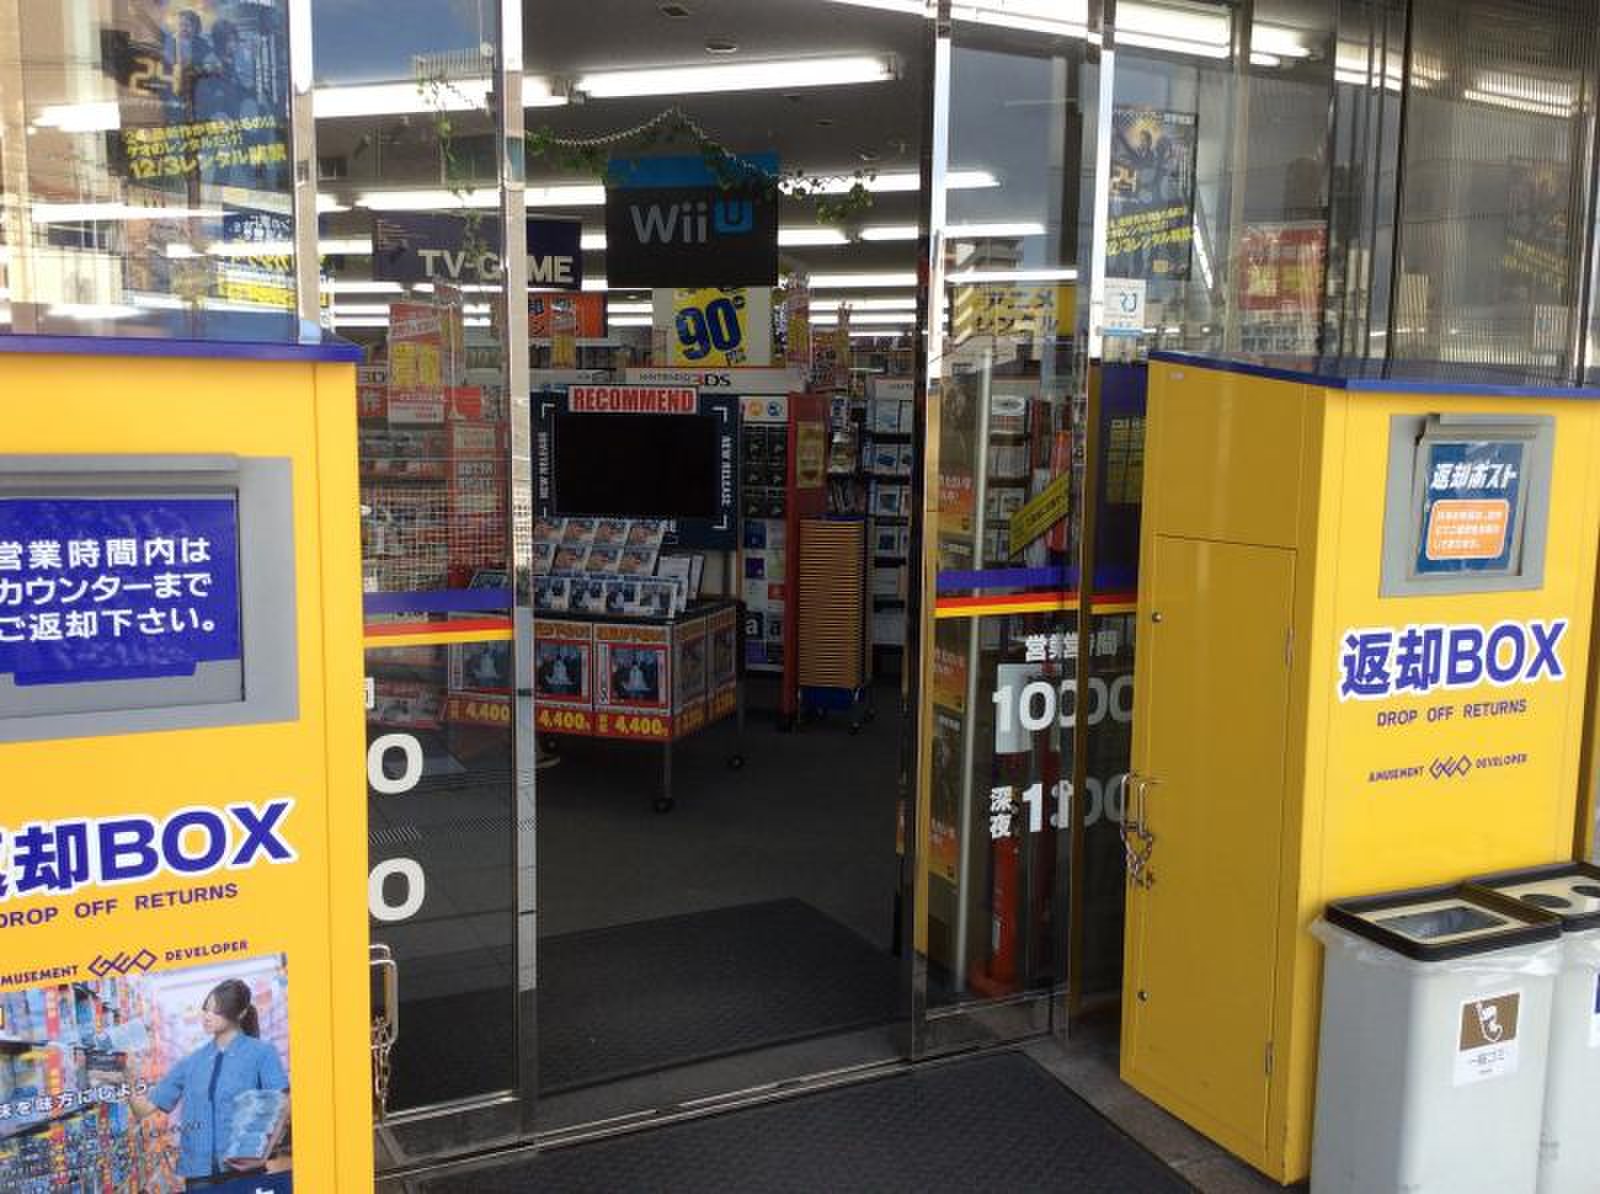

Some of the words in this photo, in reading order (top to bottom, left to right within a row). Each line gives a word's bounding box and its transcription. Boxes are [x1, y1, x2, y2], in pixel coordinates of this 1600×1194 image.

[630, 202, 707, 244] Wii
[417, 249, 573, 283] TV-GME
[692, 371, 732, 386] 3DS
[574, 387, 695, 411] RECOMMEND
[0, 536, 212, 571] 営業時間内は
[0, 571, 213, 606] カウンターまで
[1339, 620, 1567, 699] 返却BOX
[1377, 709, 1417, 727] DROP
[1427, 706, 1454, 723] OFF
[1463, 698, 1527, 718] RETURNS
[1368, 765, 1425, 782] AMUSEMENT
[1476, 753, 1528, 769] DEVELOPER
[0, 799, 294, 898] 却BOX
[74, 899, 118, 918] OFF
[135, 882, 238, 911] RETURNS
[0, 965, 79, 986] MUSEMENT
[165, 939, 249, 962] DEVELOPER
